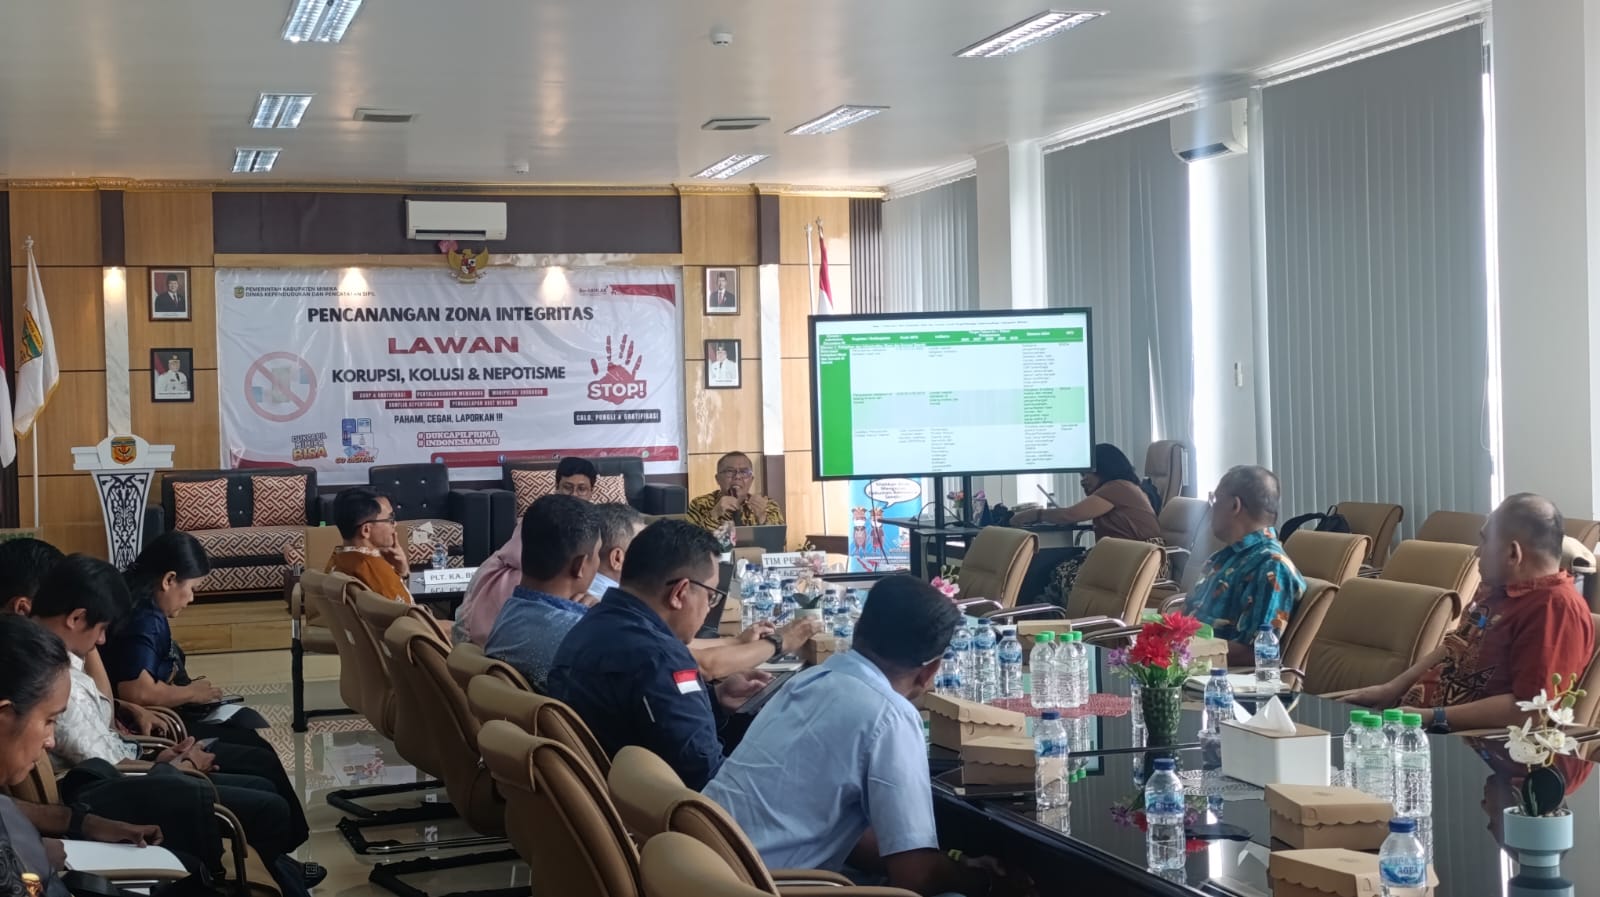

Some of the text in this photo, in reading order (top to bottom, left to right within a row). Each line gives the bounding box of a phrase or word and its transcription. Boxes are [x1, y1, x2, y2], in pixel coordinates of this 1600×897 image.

[308, 306, 594, 322] PENCANANGAN ZONA INTEGRITAS
[388, 336, 519, 354] LAWAN
[332, 366, 566, 384] KORUPSI, KOLUSI & NEPOTISME
[590, 383, 645, 397] STOP!
[394, 415, 425, 424] PAHAMI,
[427, 414, 453, 423] CEGAH,
[456, 413, 494, 422] LAPORKAN
[417, 430, 498, 440] #DUKCAPILPRIMA
[417, 438, 500, 447] #INDONESIAMAJU
[293, 446, 327, 461] BISA
[764, 557, 781, 565] TIM
